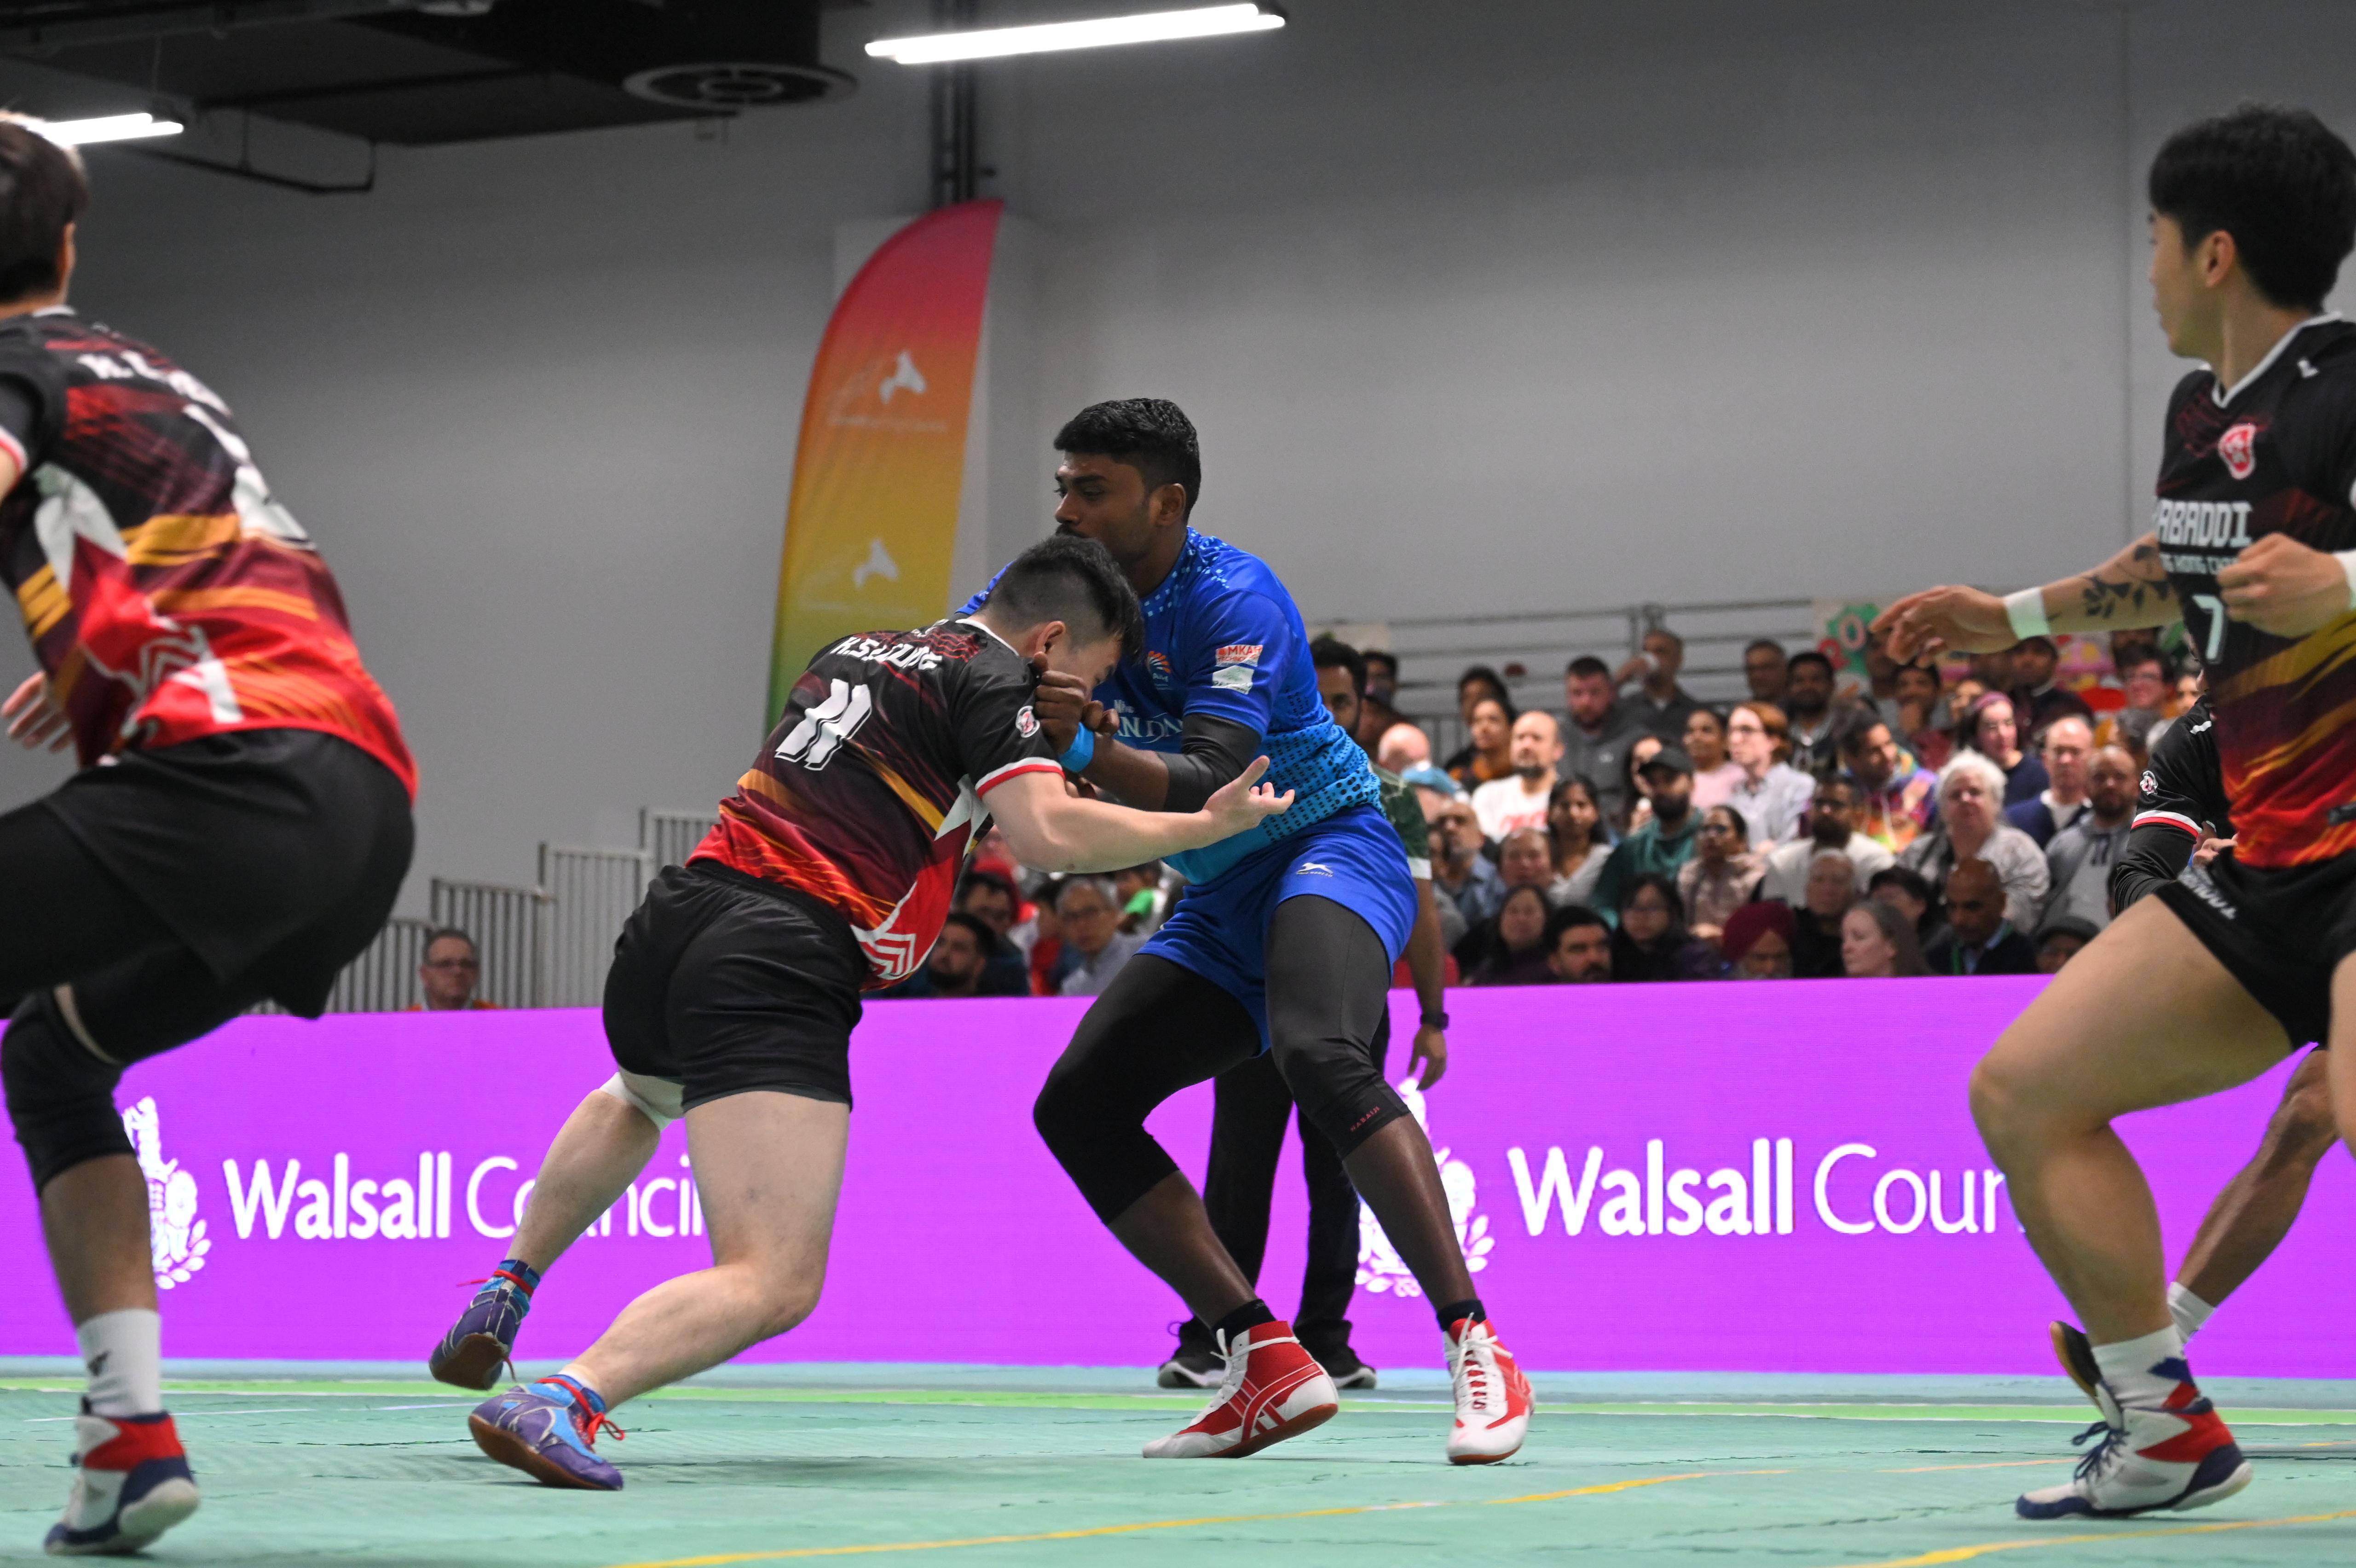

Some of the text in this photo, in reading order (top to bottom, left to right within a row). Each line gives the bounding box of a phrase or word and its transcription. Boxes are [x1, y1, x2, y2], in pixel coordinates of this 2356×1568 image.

[2155, 499, 2253, 547] ABADDI
[2192, 594, 2225, 663] 7
[223, 1152, 450, 1239] Walsall
[1508, 1138, 1793, 1236] Walsall
